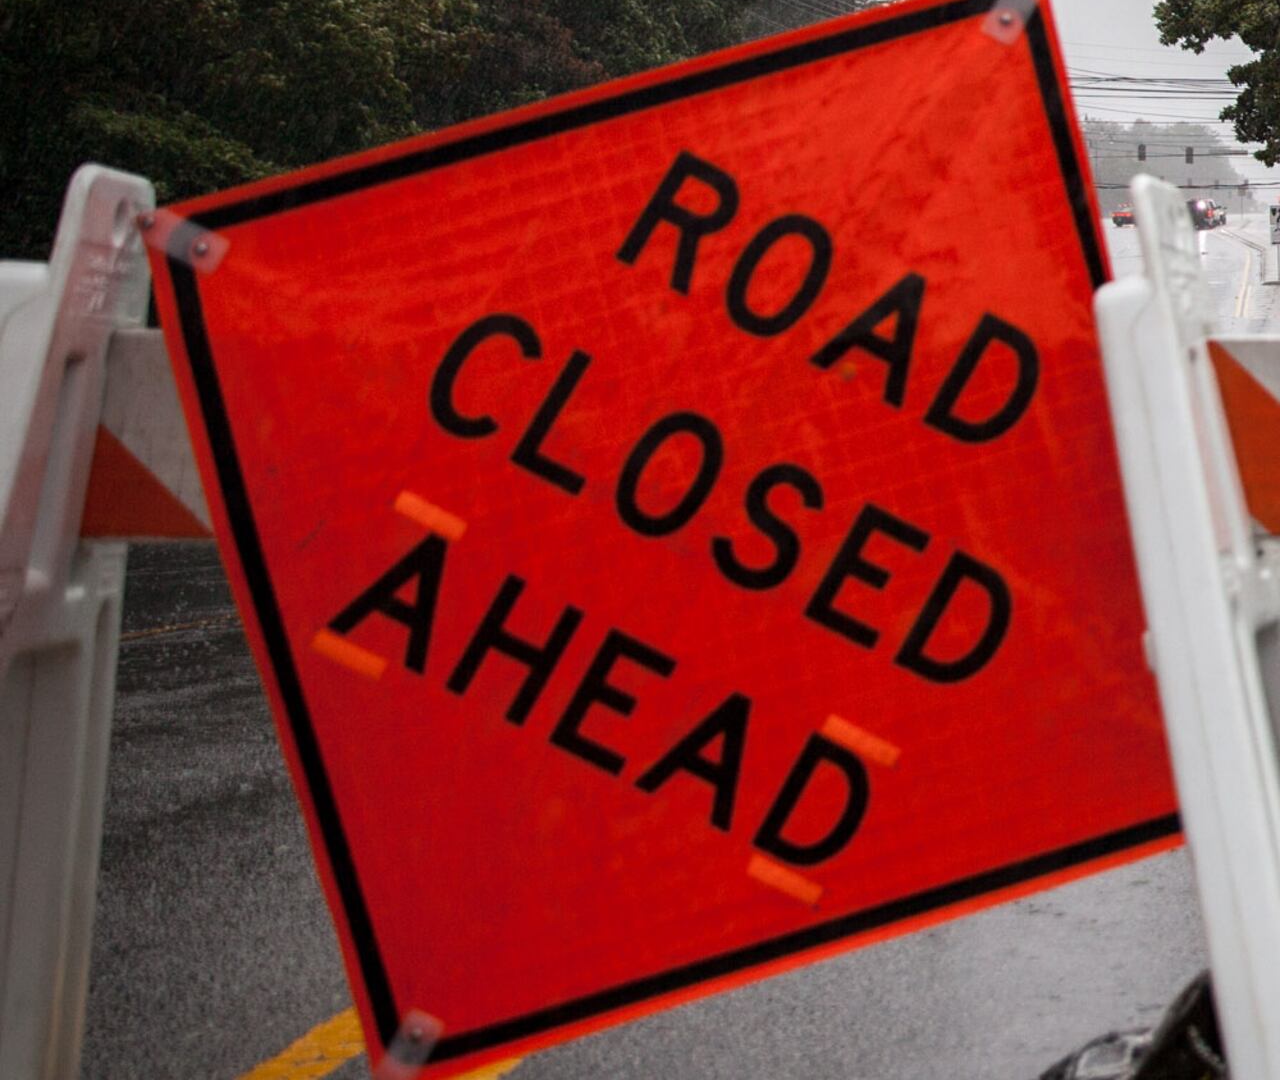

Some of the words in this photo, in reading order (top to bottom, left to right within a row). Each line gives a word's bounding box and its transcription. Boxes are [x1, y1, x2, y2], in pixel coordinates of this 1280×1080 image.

[615, 150, 1040, 444] ROAD
[429, 313, 1013, 684] CLOSED
[327, 533, 870, 867] AHEAD
